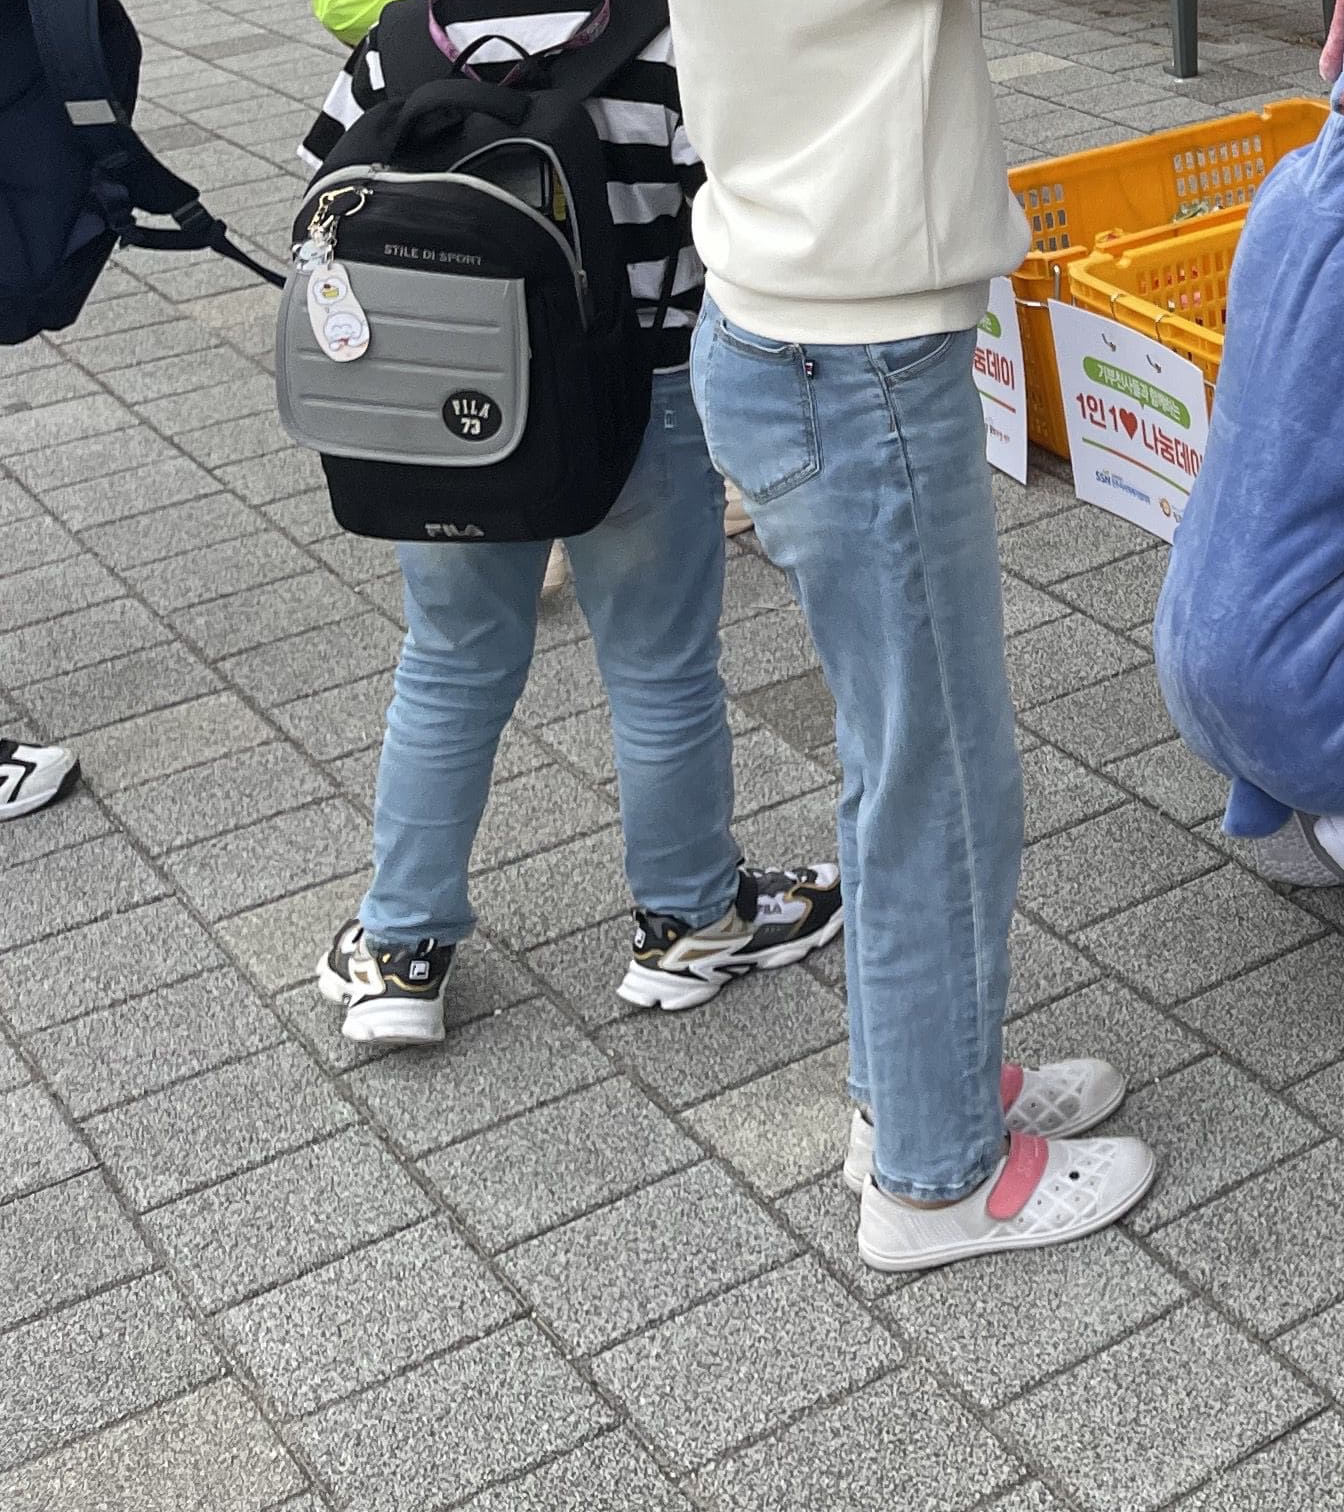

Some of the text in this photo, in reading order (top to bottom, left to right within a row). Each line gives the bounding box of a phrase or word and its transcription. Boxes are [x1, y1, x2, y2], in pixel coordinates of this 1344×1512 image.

[383, 244, 419, 260] STILE
[452, 398, 491, 420] FILA
[1076, 392, 1106, 430] 1인
[460, 418, 482, 435] 73
[424, 523, 485, 537] FILA
